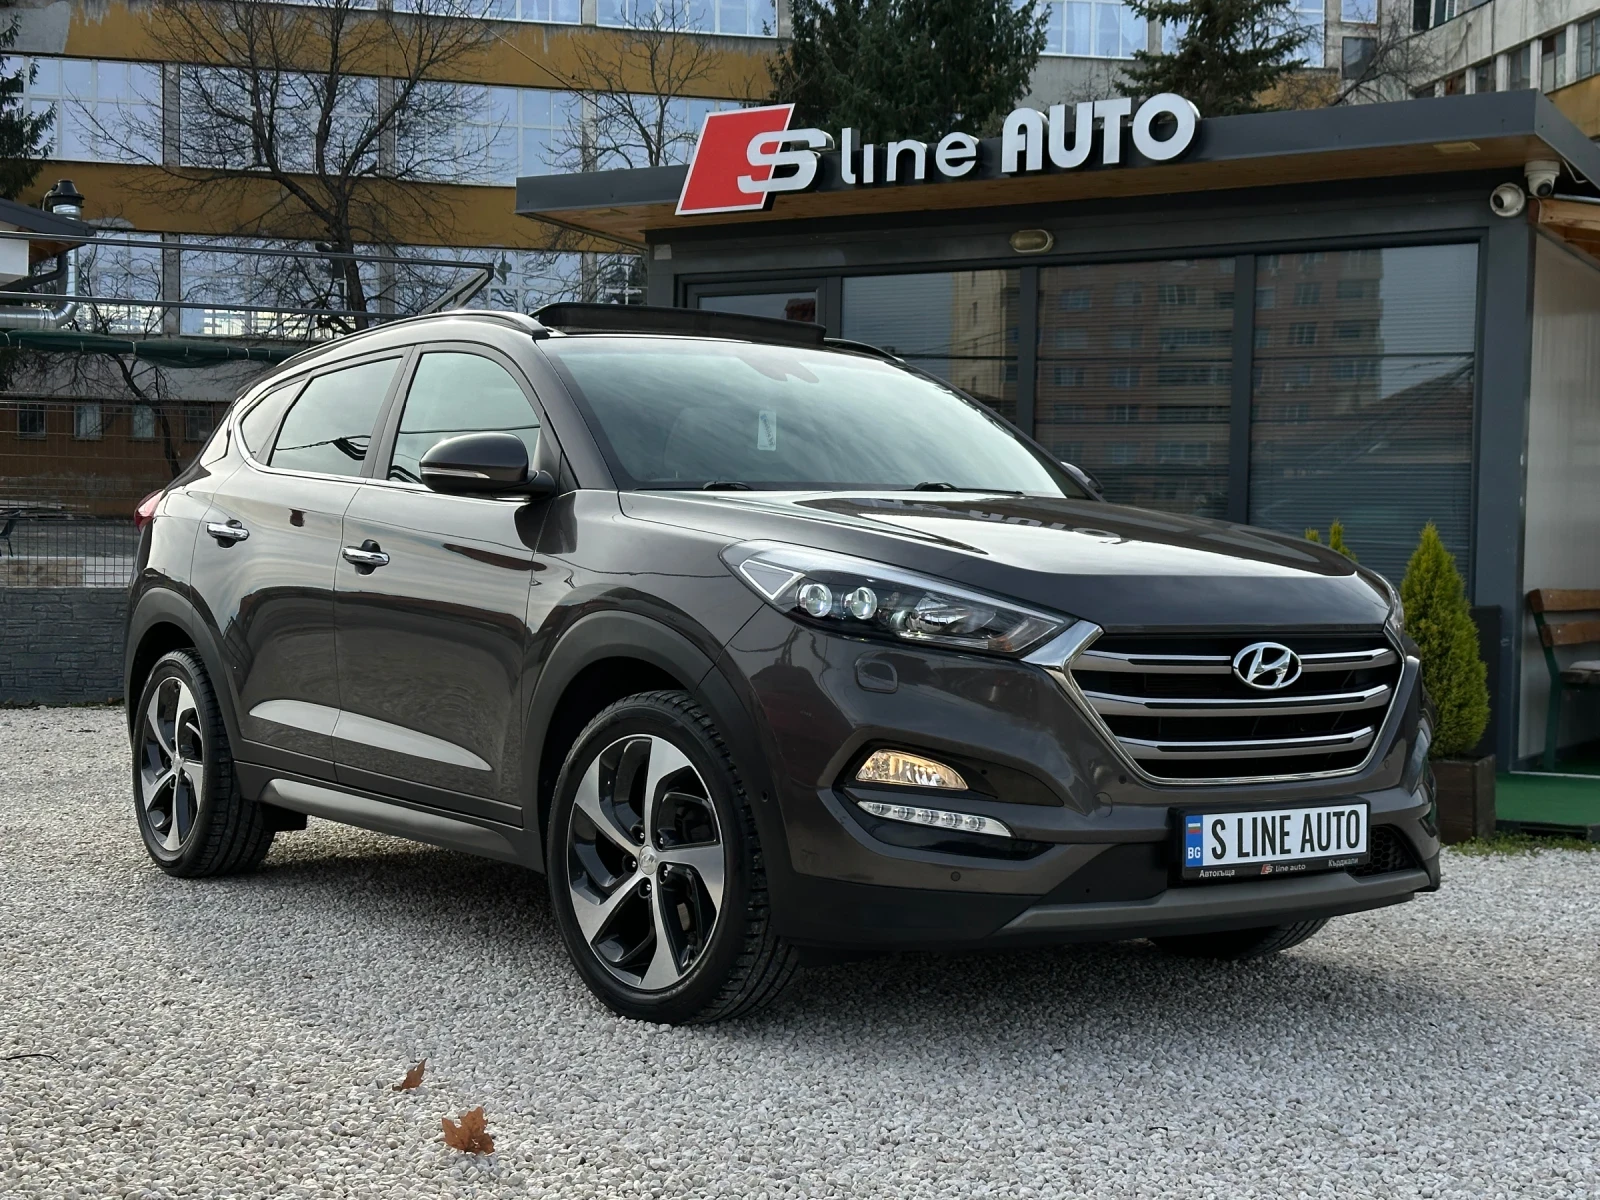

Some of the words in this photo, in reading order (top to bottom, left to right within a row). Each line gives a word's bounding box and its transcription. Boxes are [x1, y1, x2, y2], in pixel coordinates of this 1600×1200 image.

[736, 127, 830, 194] S
[1000, 92, 1198, 173] AUTO
[1211, 818, 1227, 860] S
[1237, 814, 1292, 858] LINE
[1300, 809, 1361, 853] AUTO
[1187, 847, 1201, 859] BG
[1289, 863, 1307, 871] auto
